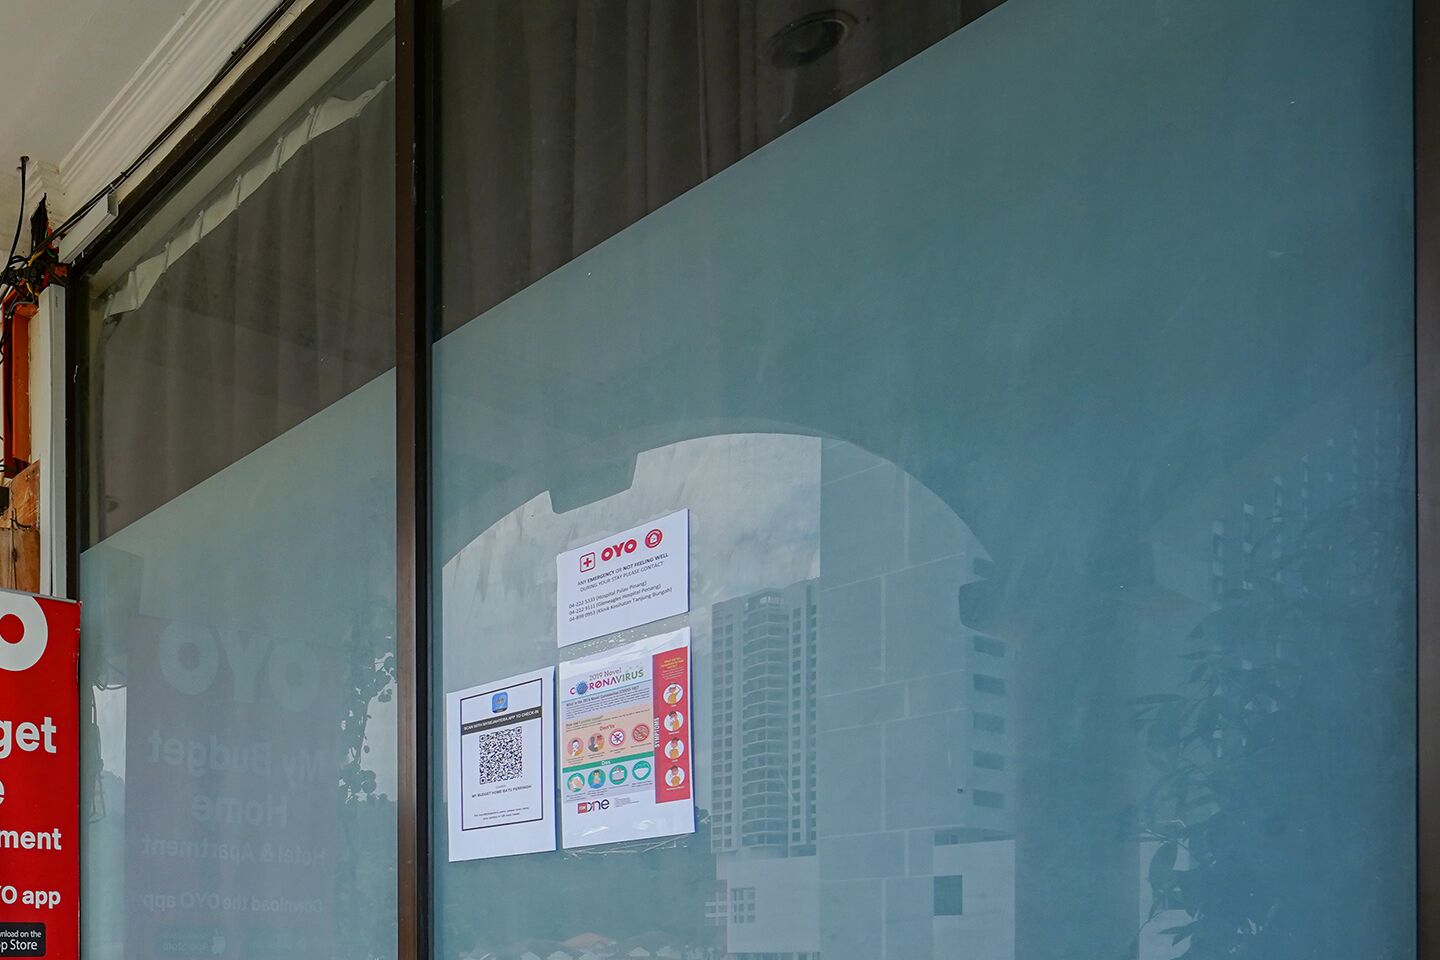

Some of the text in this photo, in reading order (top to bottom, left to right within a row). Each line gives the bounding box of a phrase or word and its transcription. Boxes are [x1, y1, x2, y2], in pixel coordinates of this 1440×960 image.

[601, 539, 637, 561] OYO
[589, 667, 622, 681] 2019 Novel
[22, 890, 61, 909] app
[10, 940, 37, 950] Store
